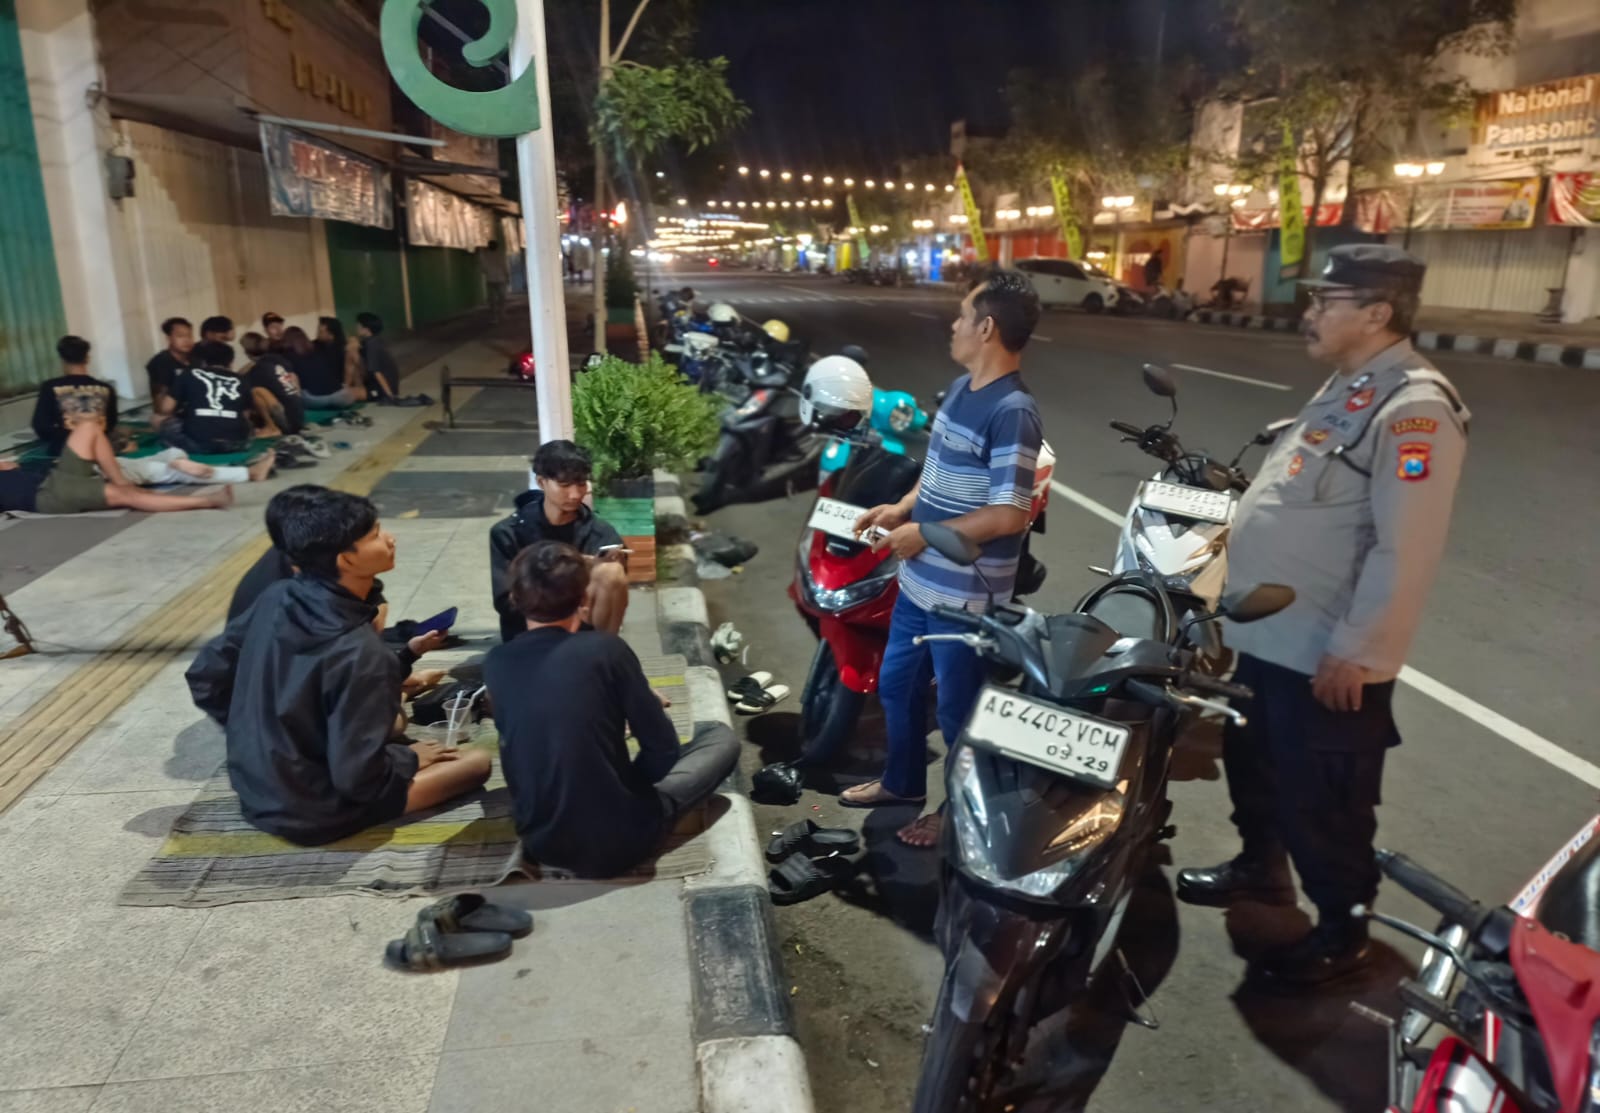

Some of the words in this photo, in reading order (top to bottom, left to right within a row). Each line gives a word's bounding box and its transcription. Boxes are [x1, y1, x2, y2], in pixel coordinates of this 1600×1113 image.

[1499, 79, 1593, 114] National
[1486, 116, 1597, 146] Panasonic
[817, 503, 832, 515] AG
[984, 696, 1014, 718] AG
[1018, 705, 1072, 738] 4402
[1077, 721, 1120, 752] VCM
